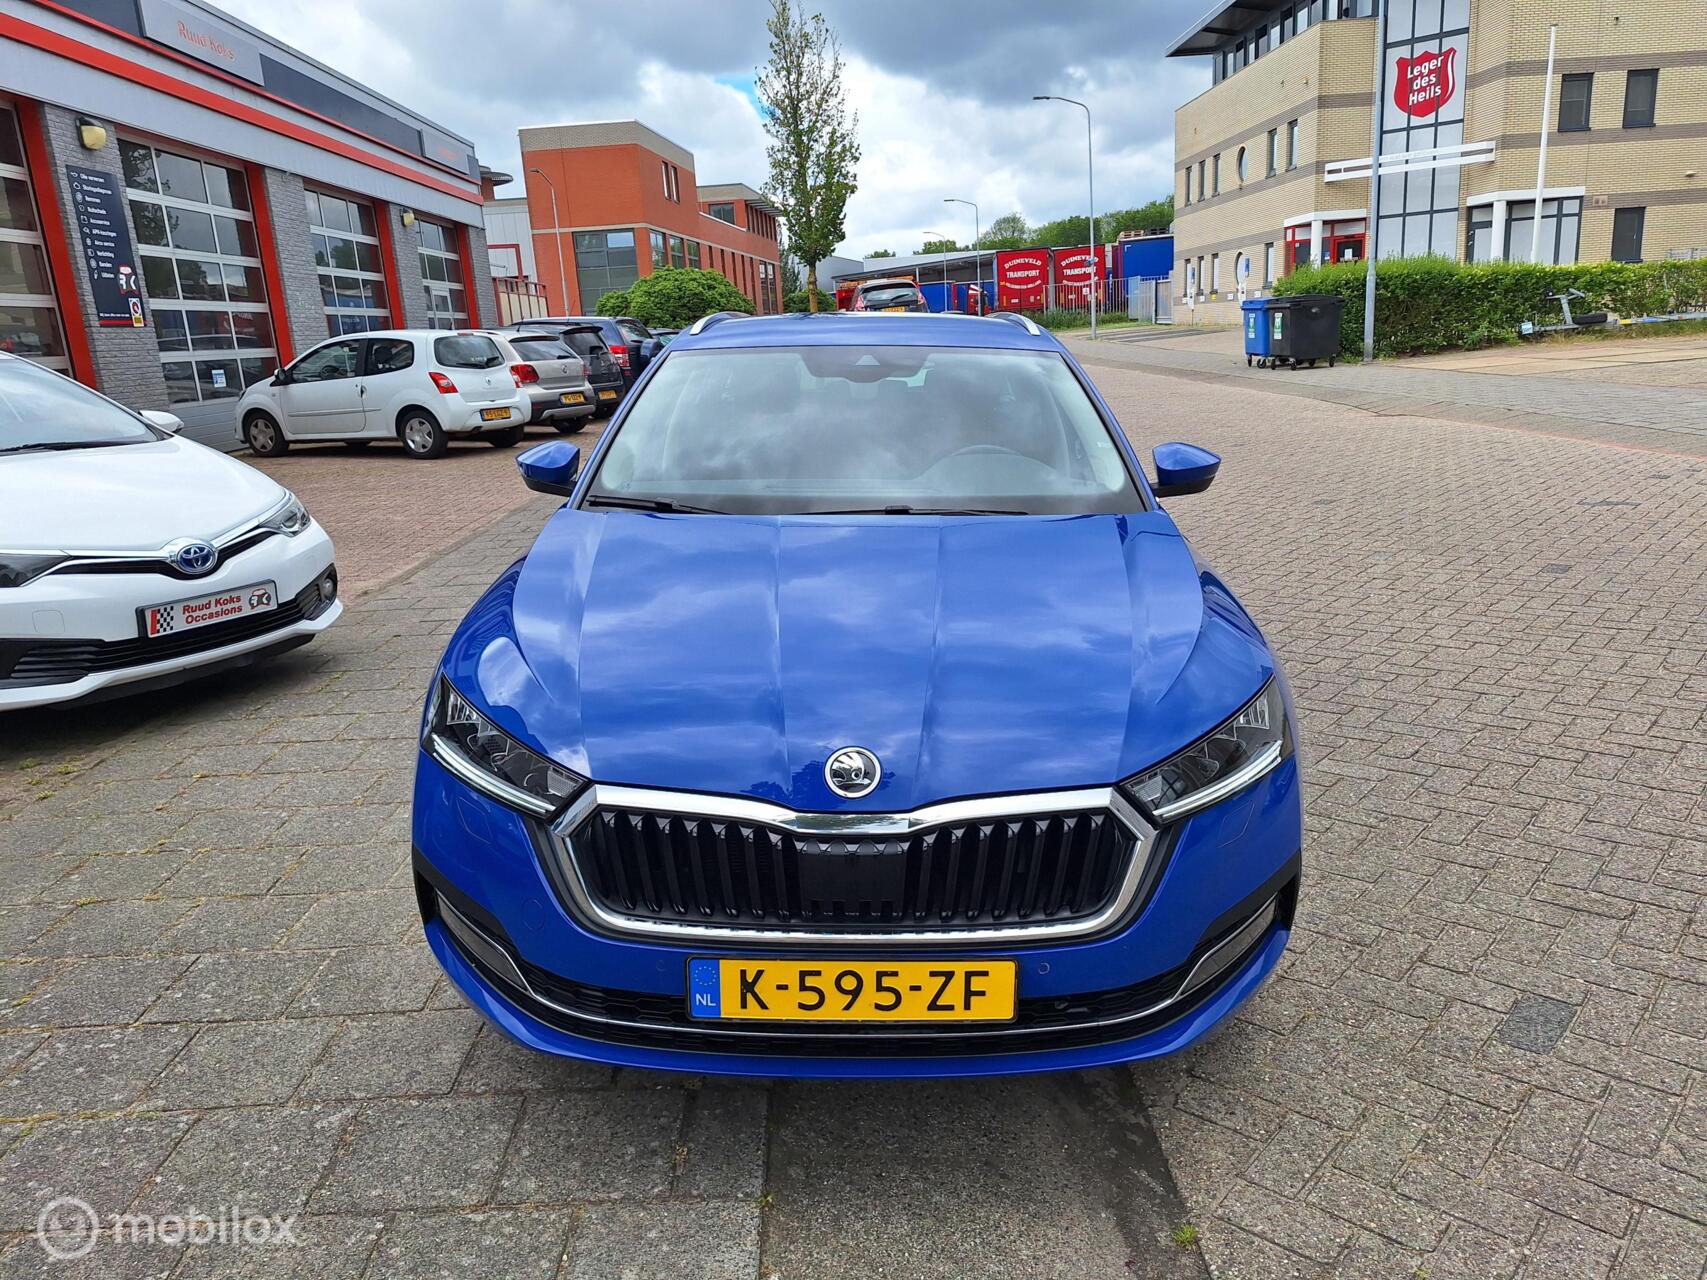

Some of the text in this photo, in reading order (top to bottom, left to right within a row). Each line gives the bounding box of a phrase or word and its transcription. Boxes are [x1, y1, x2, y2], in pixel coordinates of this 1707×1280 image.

[1407, 56, 1444, 79] Leger
[1413, 74, 1436, 90] des
[1409, 85, 1441, 106] Heils
[1004, 258, 1042, 269] DUINEVELD
[1006, 269, 1040, 278] TRANSPORT
[182, 595, 242, 615] Ruud Koks
[185, 605, 243, 625] Occasions
[695, 969, 990, 1012] NL K-595-ZF
